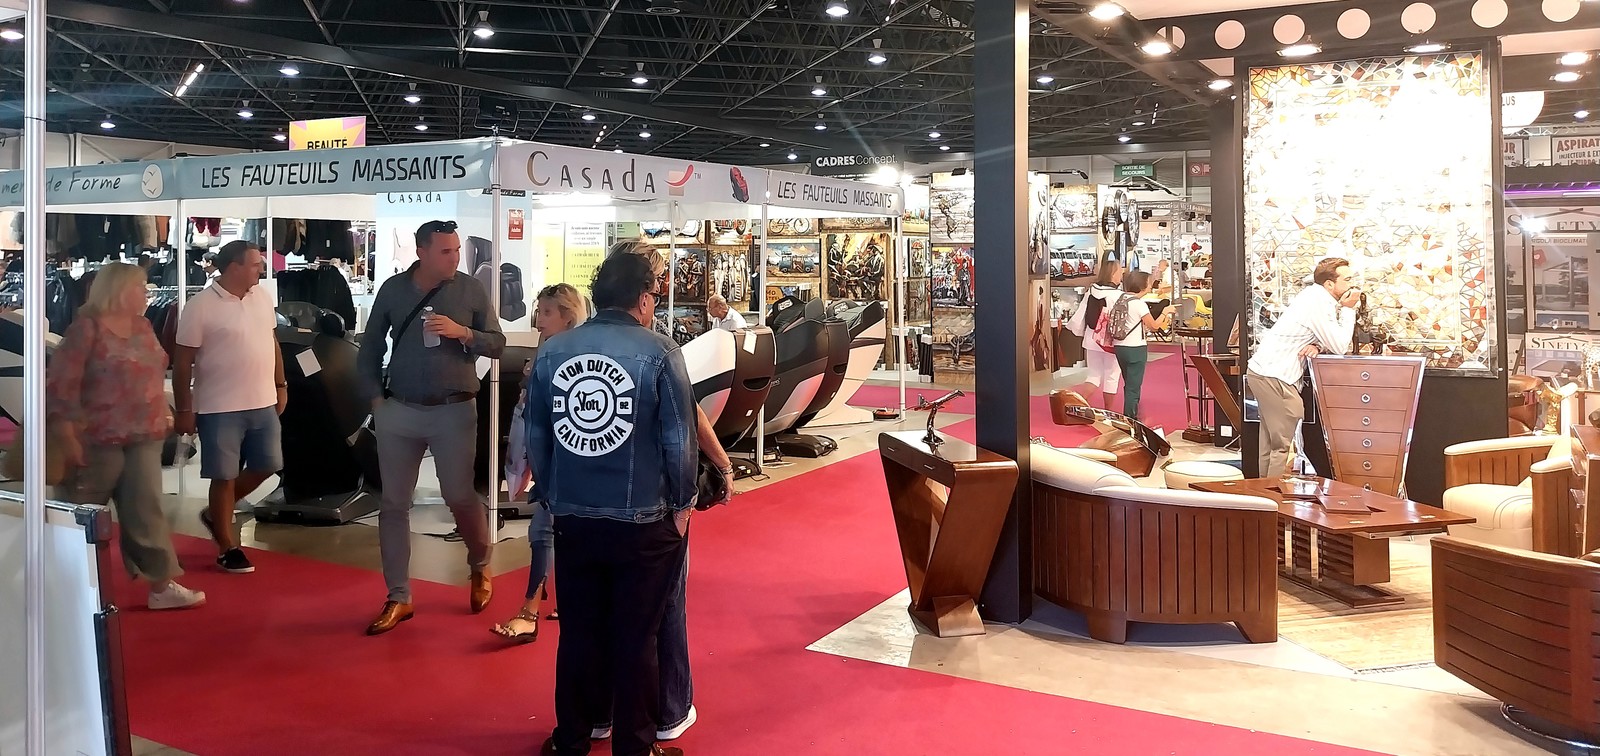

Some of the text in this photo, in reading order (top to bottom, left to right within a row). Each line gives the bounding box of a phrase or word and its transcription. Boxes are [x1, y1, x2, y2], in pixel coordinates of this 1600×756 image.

[1558, 151, 1586, 160] INJECTEUR
[68, 170, 121, 192] Forme
[201, 154, 467, 189] LES FAUTEUILS MASSANTS
[777, 180, 893, 209] LES FAUTEUILS MASSANTS
[558, 359, 626, 386] VON DUTCH
[575, 390, 602, 413] Von
[557, 424, 626, 451] CALIFORNIA
